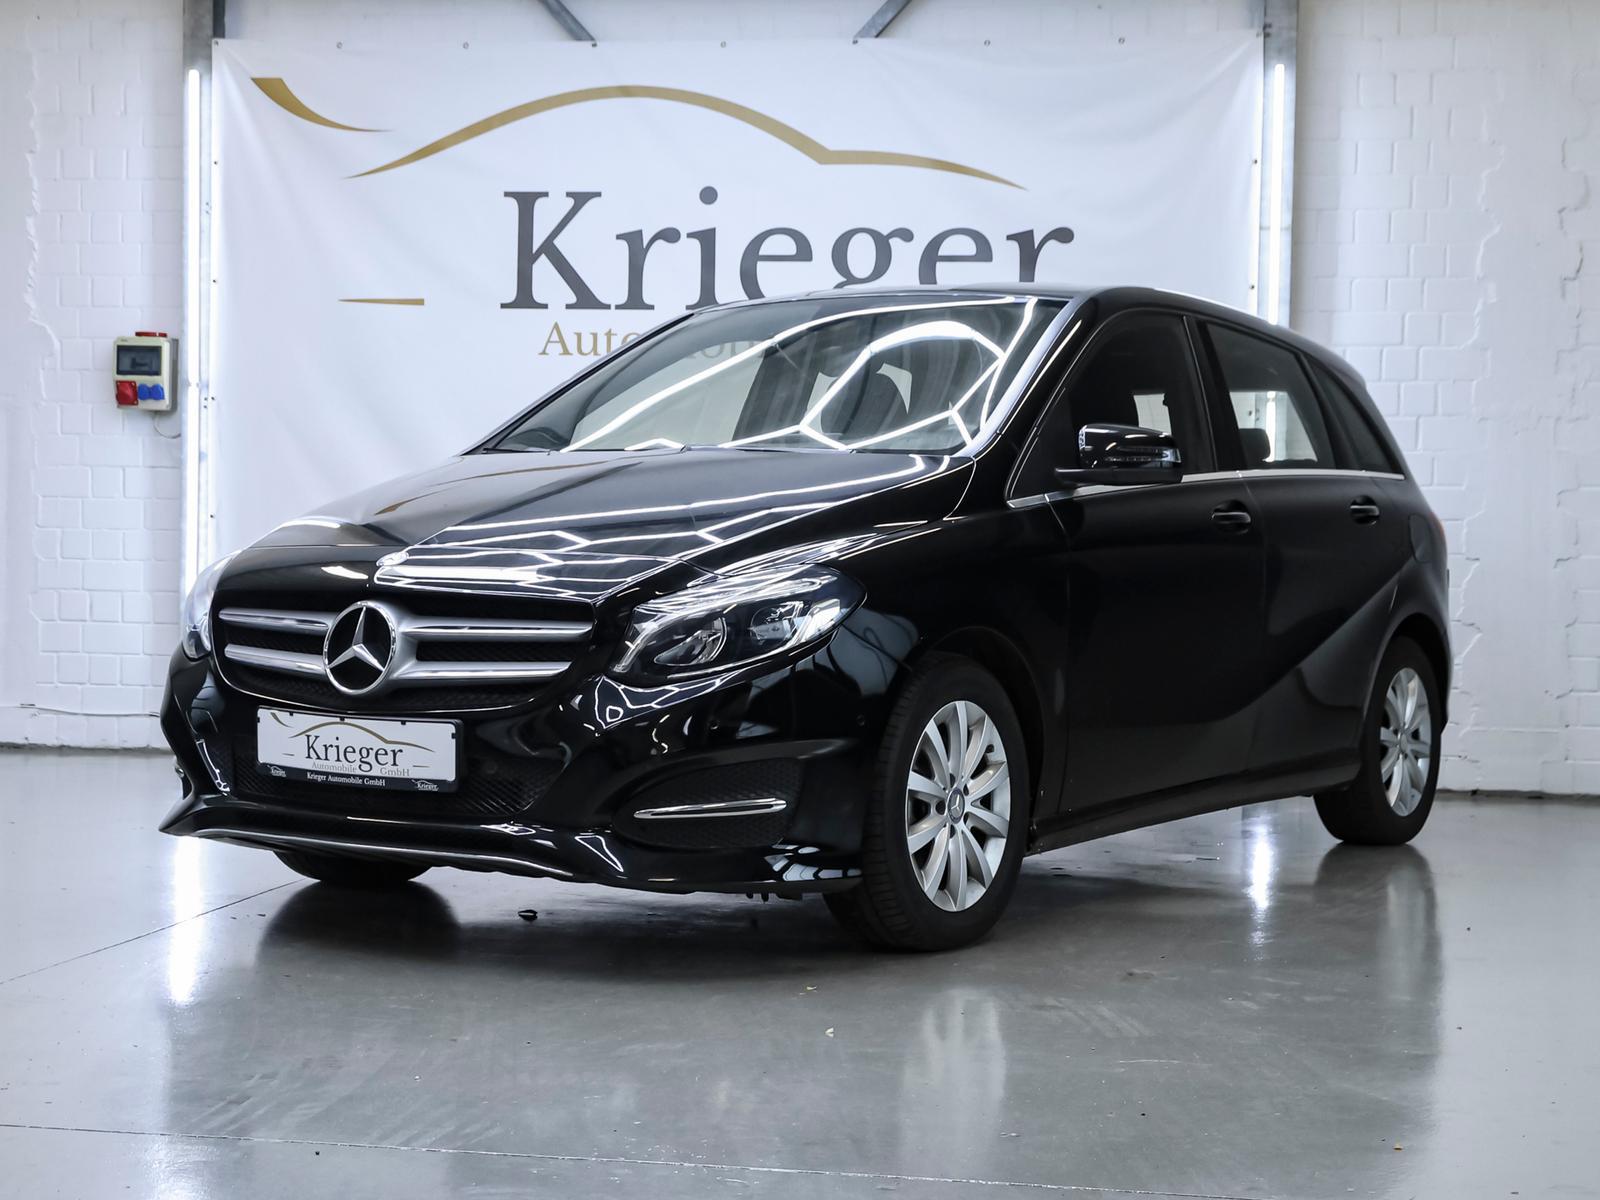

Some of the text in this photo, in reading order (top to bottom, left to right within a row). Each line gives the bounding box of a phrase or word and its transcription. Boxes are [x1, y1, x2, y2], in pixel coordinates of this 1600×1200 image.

[500, 185, 1075, 310] Krieger
[305, 734, 404, 773] Krieger
[307, 771, 386, 787] Krieger Automobile GmbH
[312, 761, 410, 777] Automobile GmbH
